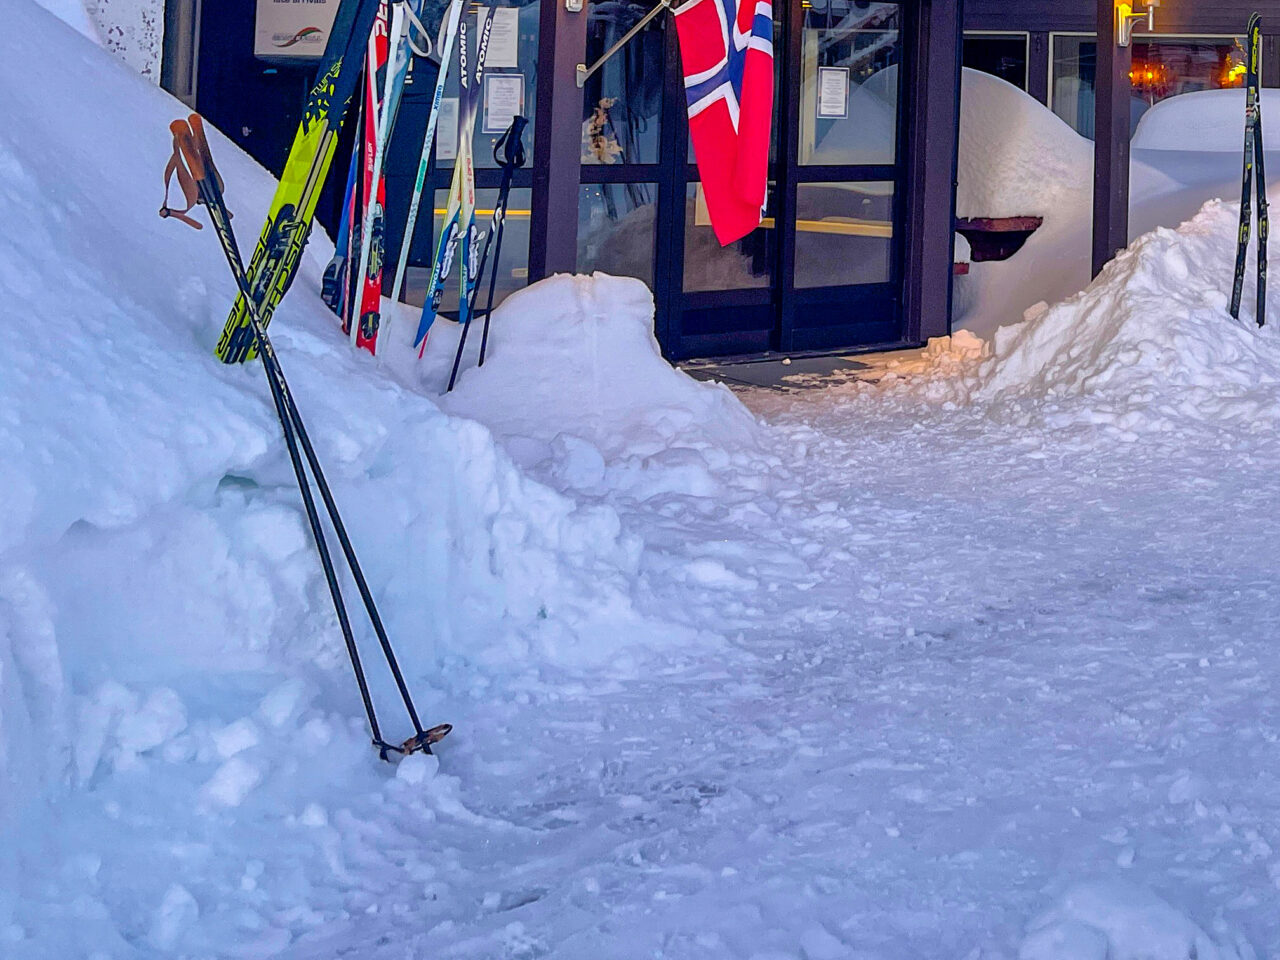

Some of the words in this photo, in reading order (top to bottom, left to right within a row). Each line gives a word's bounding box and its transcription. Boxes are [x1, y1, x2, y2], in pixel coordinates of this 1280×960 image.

[460, 22, 468, 89] ATOMIC
[476, 17, 492, 85] ATOMIC
[428, 261, 441, 298] ATOMIC
